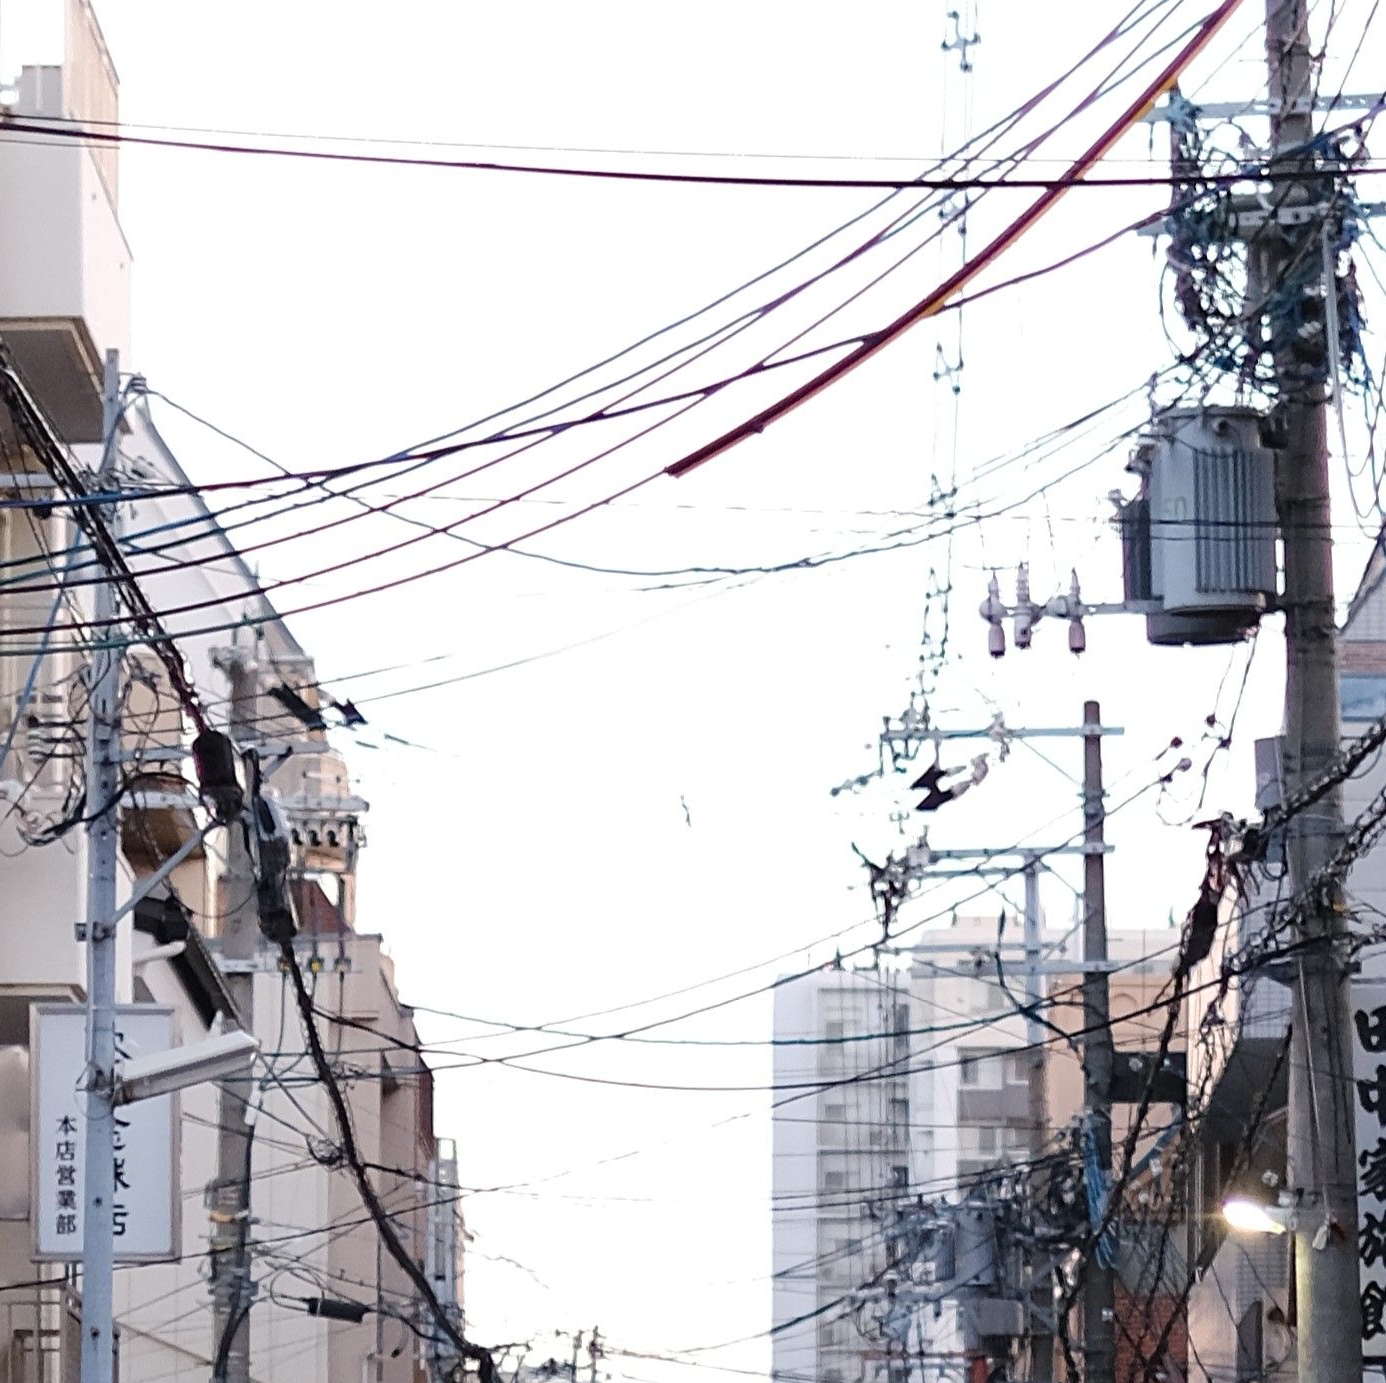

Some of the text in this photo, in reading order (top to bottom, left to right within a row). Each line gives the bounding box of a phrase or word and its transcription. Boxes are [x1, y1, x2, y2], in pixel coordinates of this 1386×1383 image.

[56, 1115, 77, 1235] 本店営業部
